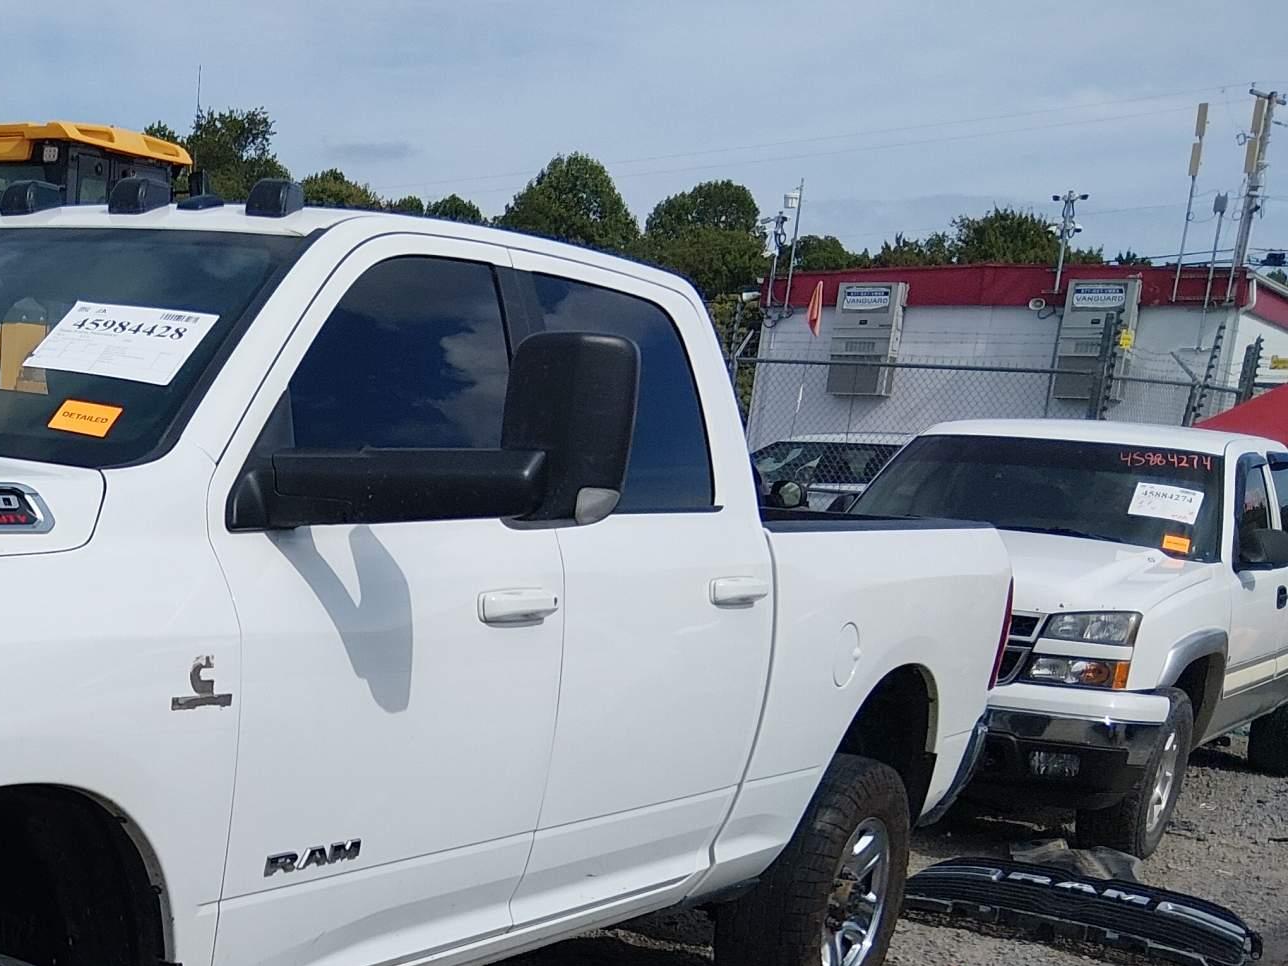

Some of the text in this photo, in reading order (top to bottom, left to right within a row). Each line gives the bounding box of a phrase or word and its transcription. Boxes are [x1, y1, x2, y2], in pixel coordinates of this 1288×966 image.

[846, 297, 888, 305] VANGUARD
[1075, 295, 1123, 303] VANGUARD
[73, 317, 188, 341] 45984428
[62, 411, 109, 424] DETAILED
[263, 838, 362, 878] RAM
